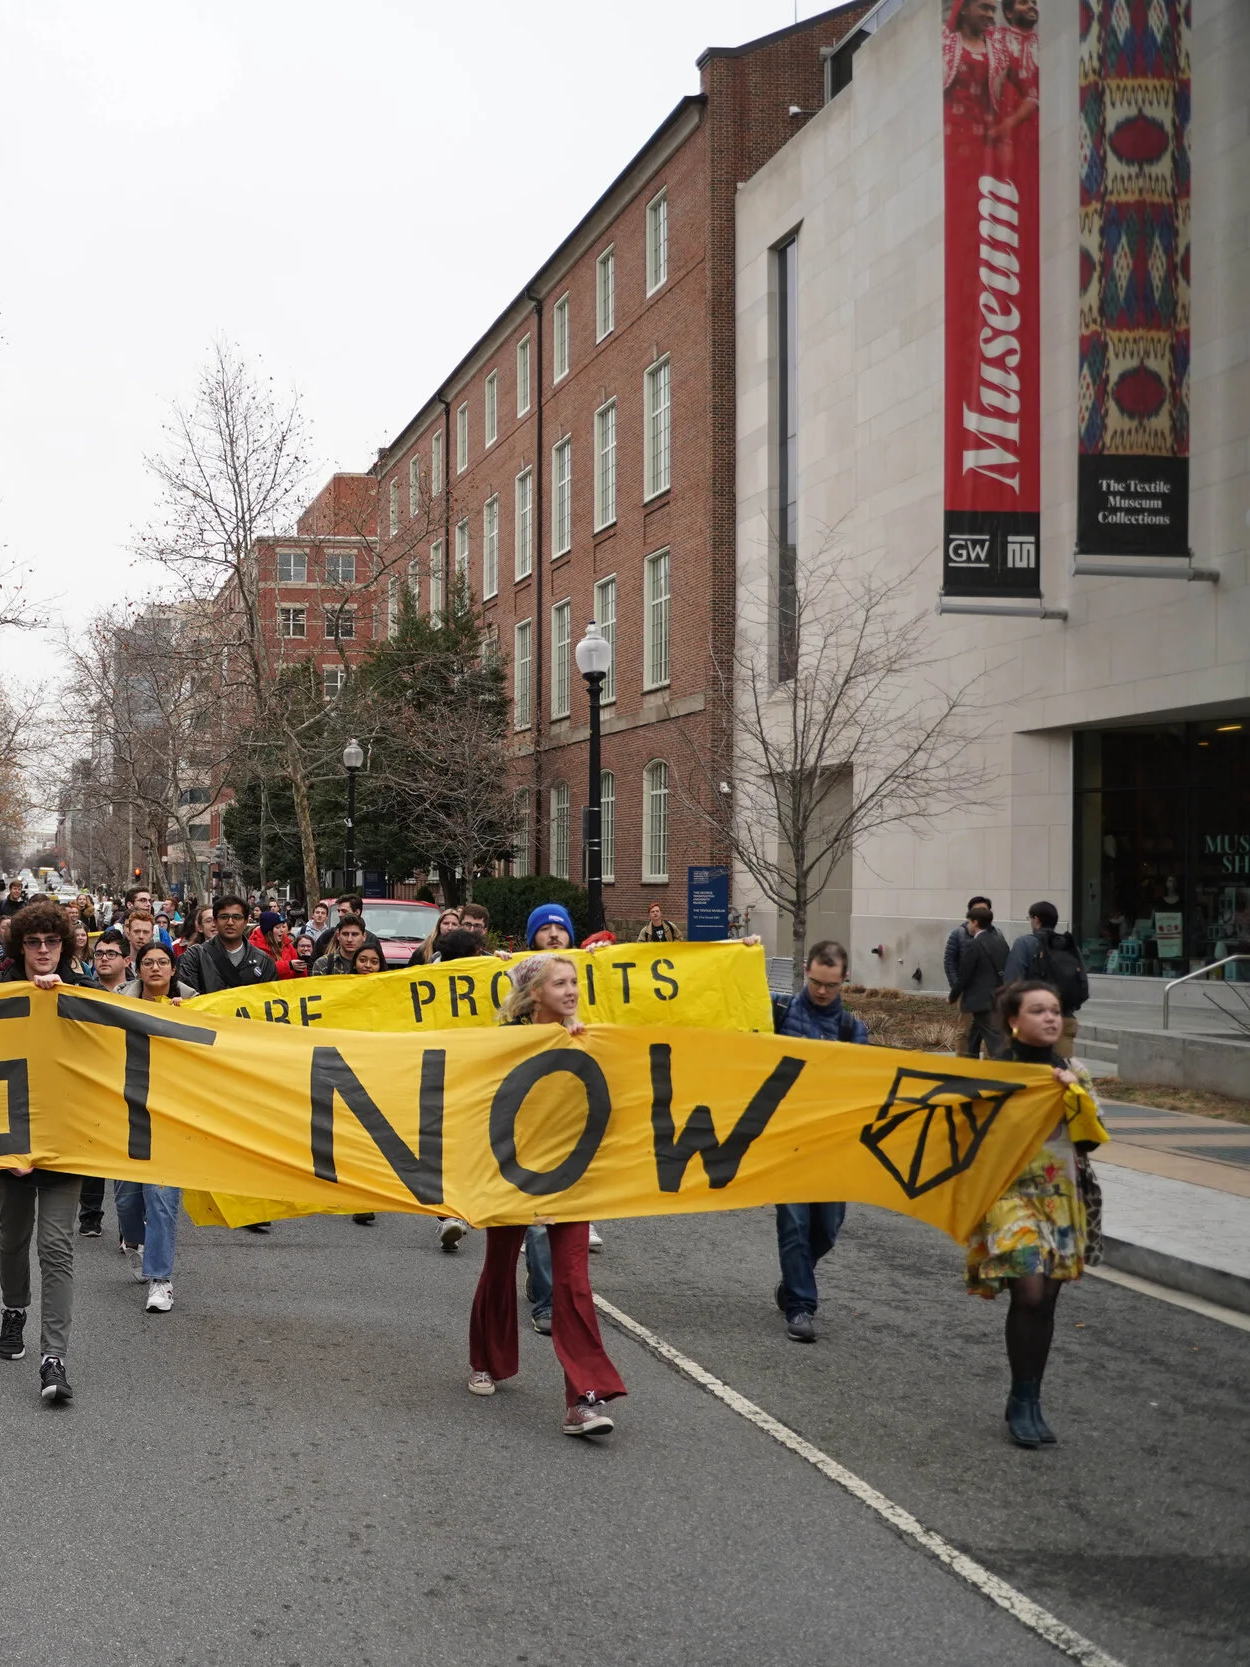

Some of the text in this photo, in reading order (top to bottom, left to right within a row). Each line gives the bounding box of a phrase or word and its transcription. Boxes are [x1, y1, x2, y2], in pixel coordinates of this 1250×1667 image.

[963, 175, 1021, 496] Museum
[1098, 479, 1171, 494] The Textile
[1107, 495, 1162, 509] Museum
[1097, 510, 1171, 526] Collections
[948, 539, 990, 562] GW
[236, 959, 679, 1027] RE PROITS
[310, 1043, 806, 1206] NOW
